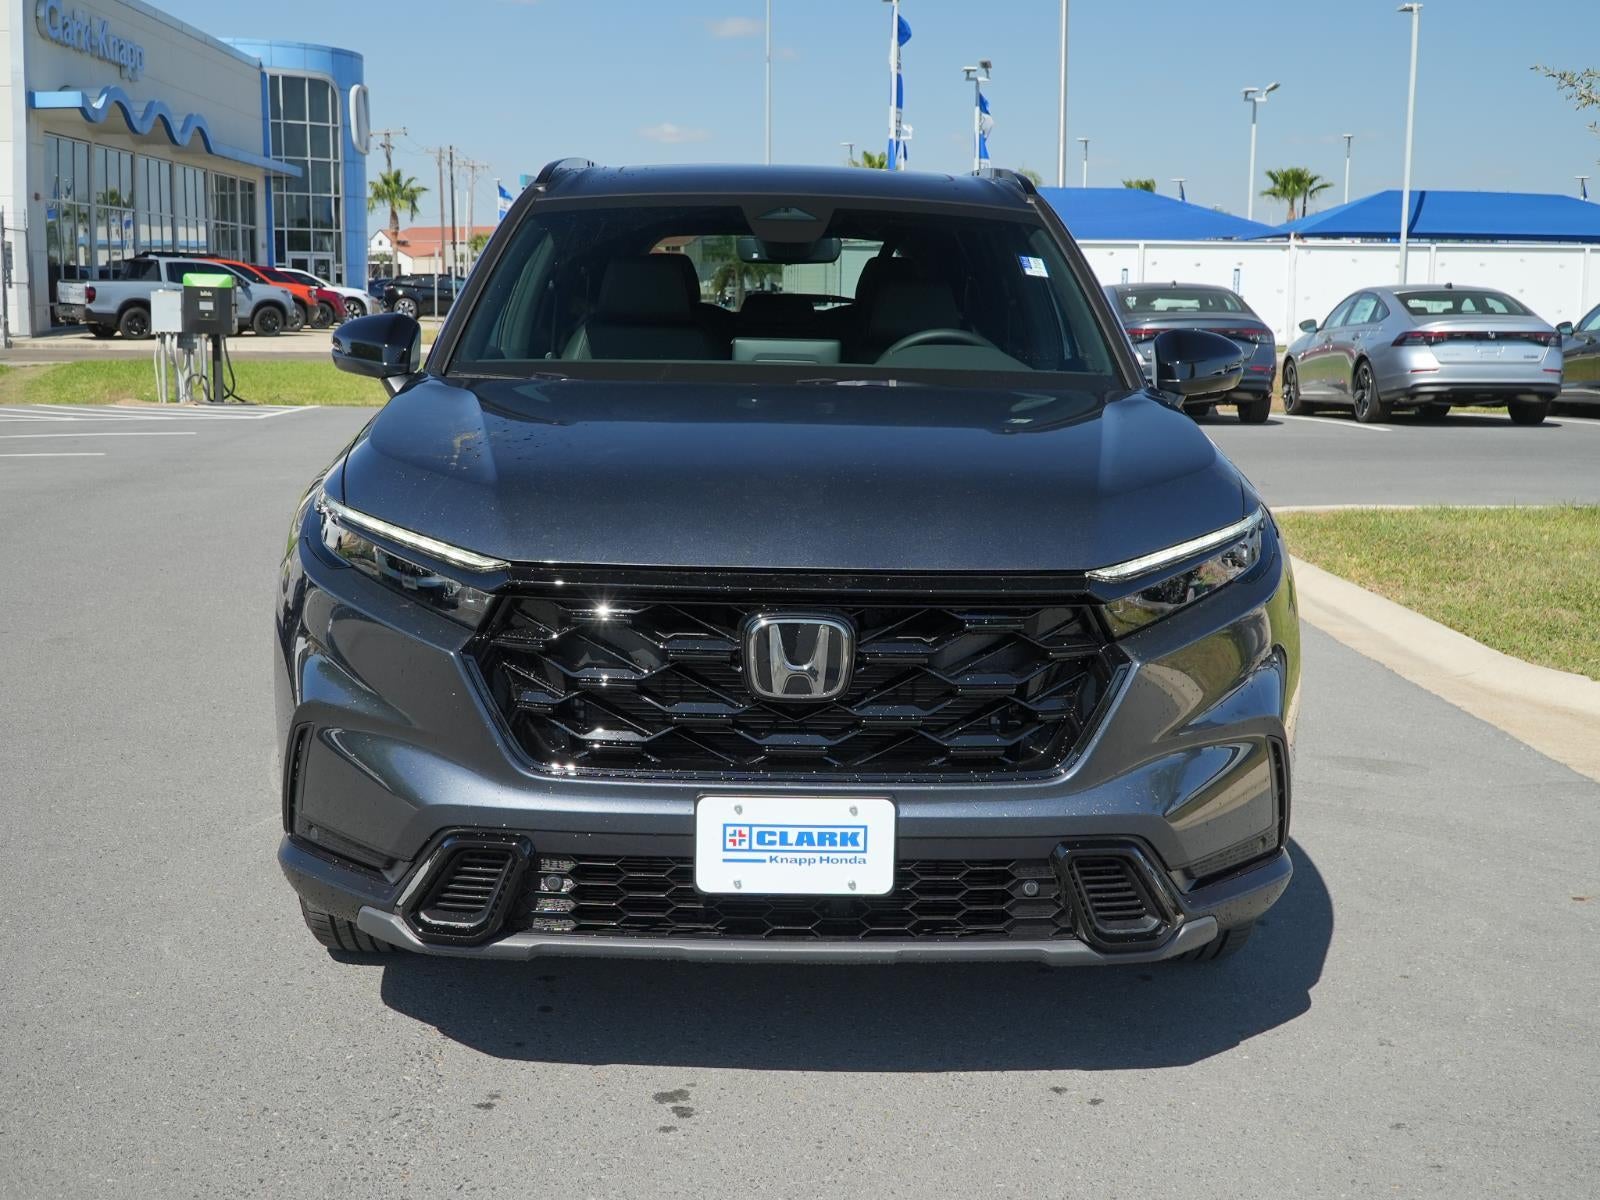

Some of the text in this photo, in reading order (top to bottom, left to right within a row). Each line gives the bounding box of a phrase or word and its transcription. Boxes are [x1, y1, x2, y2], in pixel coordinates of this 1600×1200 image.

[756, 830, 861, 847] CLARK
[769, 855, 867, 866] Knapp Honda
